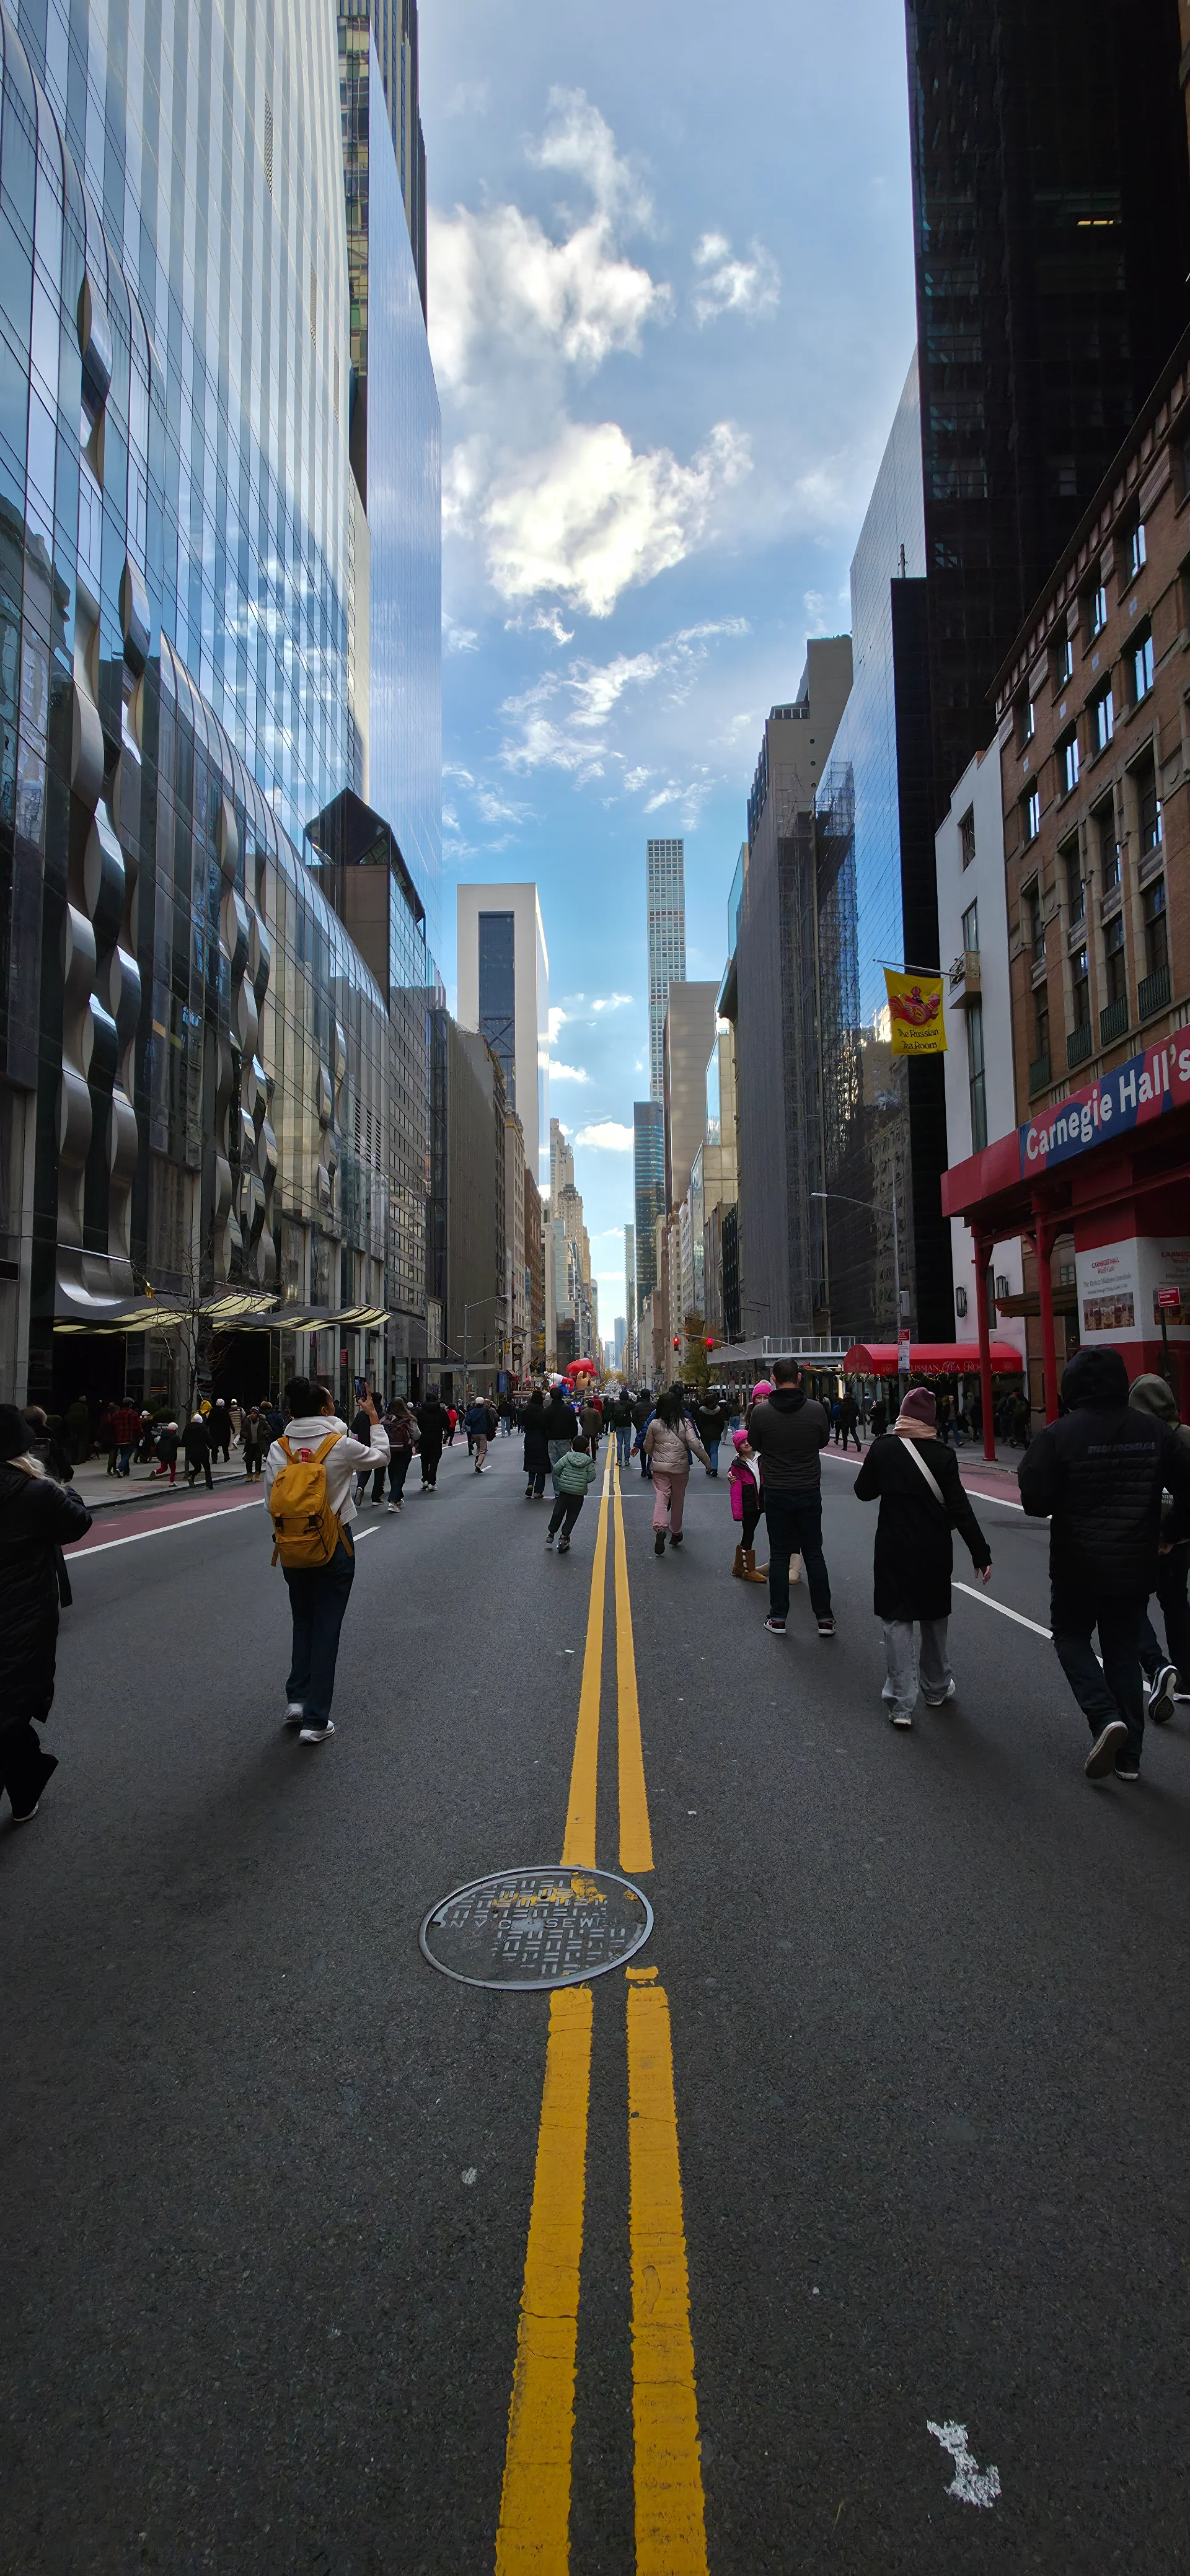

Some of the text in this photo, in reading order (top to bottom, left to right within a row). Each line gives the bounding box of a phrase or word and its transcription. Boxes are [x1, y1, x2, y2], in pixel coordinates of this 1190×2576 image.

[897, 1029, 939, 1037] The Russian
[902, 1040, 938, 1049] Tea Room
[1026, 1088, 1113, 1160] Carnegie
[910, 1363, 939, 1372] USSIAN
[964, 1360, 993, 1373] RO
